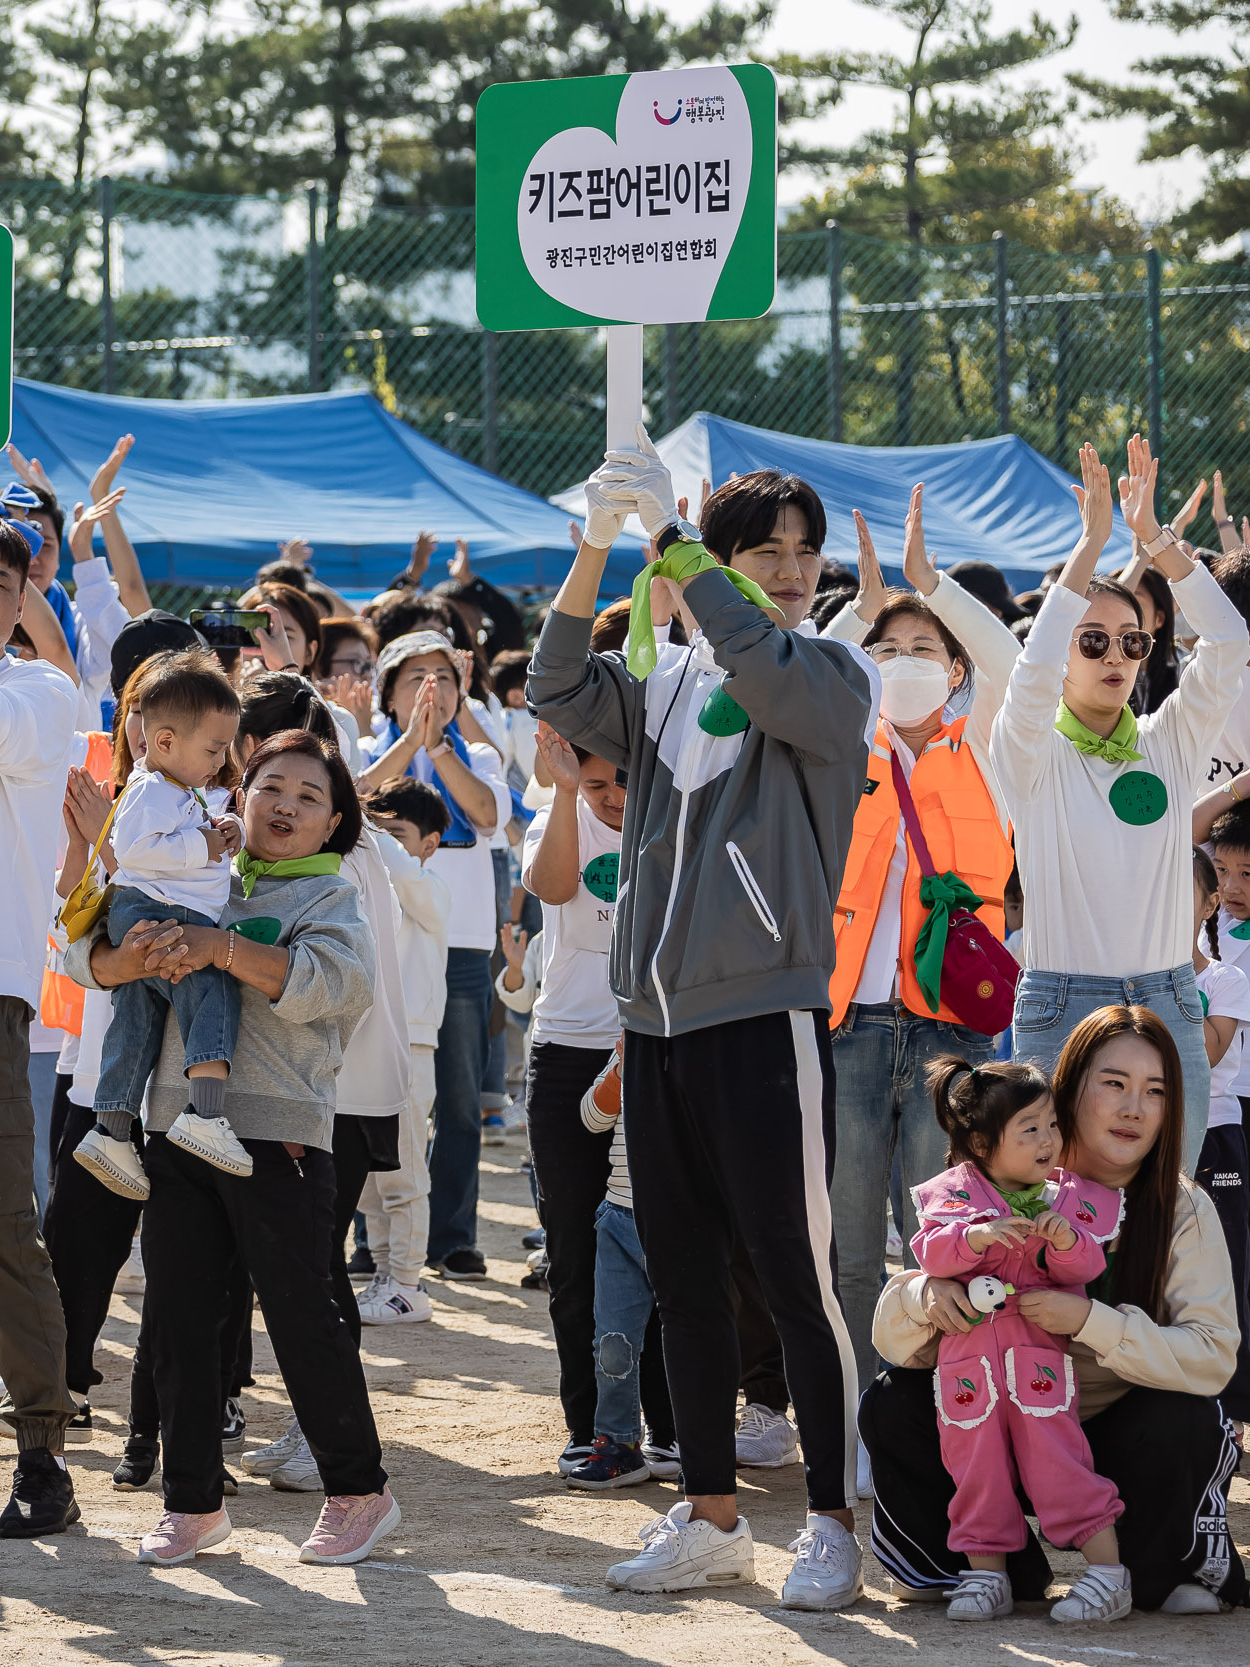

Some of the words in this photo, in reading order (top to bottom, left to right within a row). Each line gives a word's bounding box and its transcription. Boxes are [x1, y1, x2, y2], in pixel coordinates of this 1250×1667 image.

[685, 105, 725, 124] 행복광진
[528, 159, 730, 223] 키즈팜어린이집
[545, 238, 717, 268] 광진구민간어린이집연합회
[1212, 1179, 1242, 1187] FRIENDS
[1214, 1172, 1239, 1180] KAKAO
